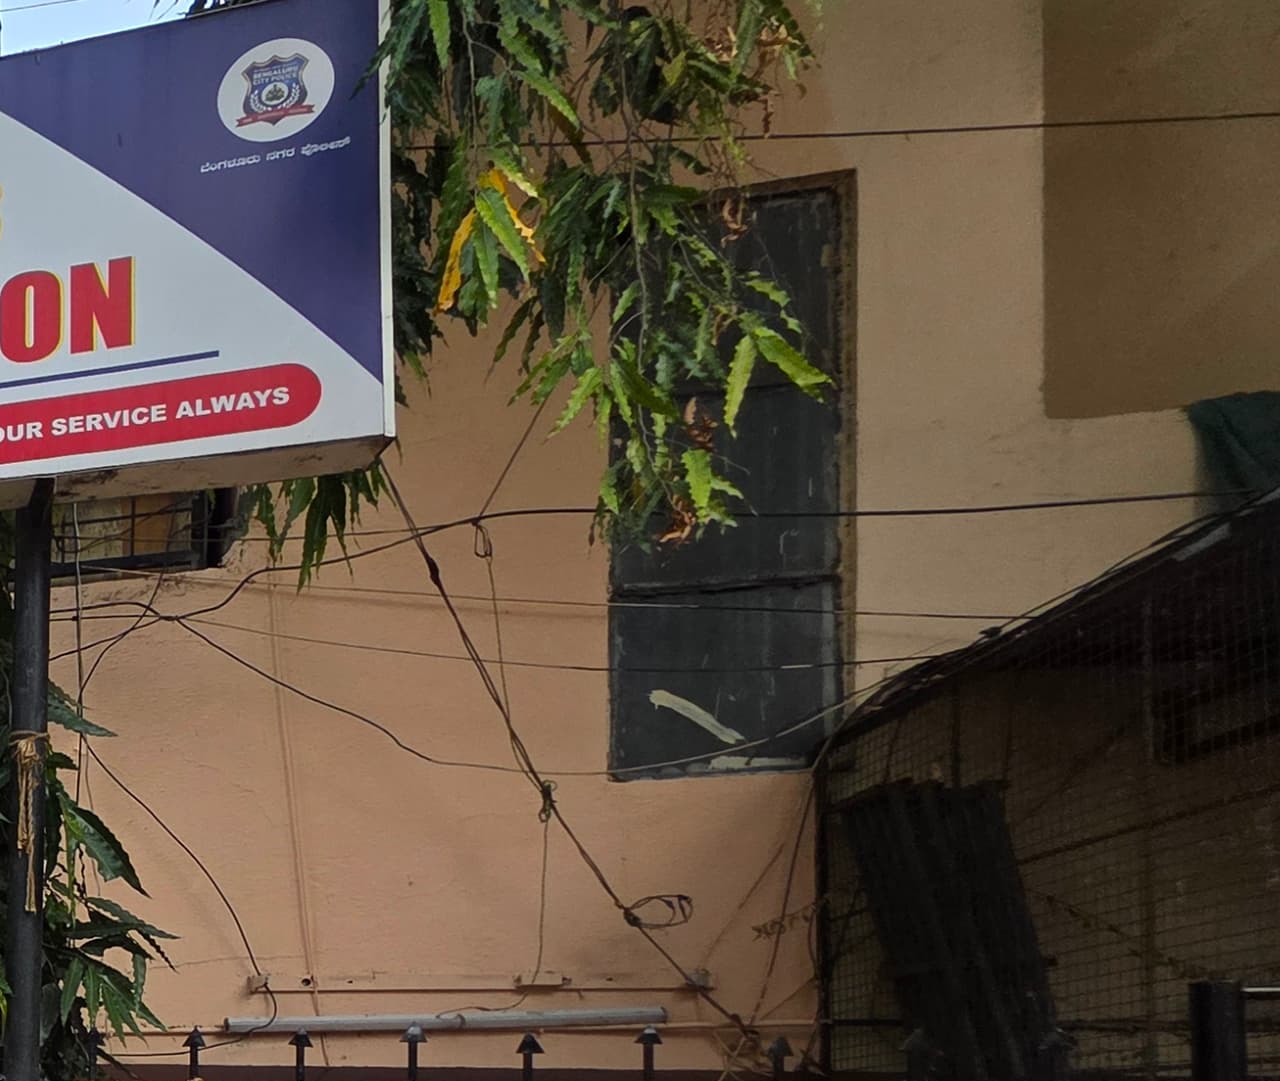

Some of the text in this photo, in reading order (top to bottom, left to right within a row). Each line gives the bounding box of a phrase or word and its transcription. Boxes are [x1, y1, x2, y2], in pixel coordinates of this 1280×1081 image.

[266, 147, 296, 161] ನಗರ
[300, 135, 352, 156] ಪೊಲೀಸ್
[51, 404, 167, 437] SERVICE
[175, 386, 290, 420] ALWAYS
